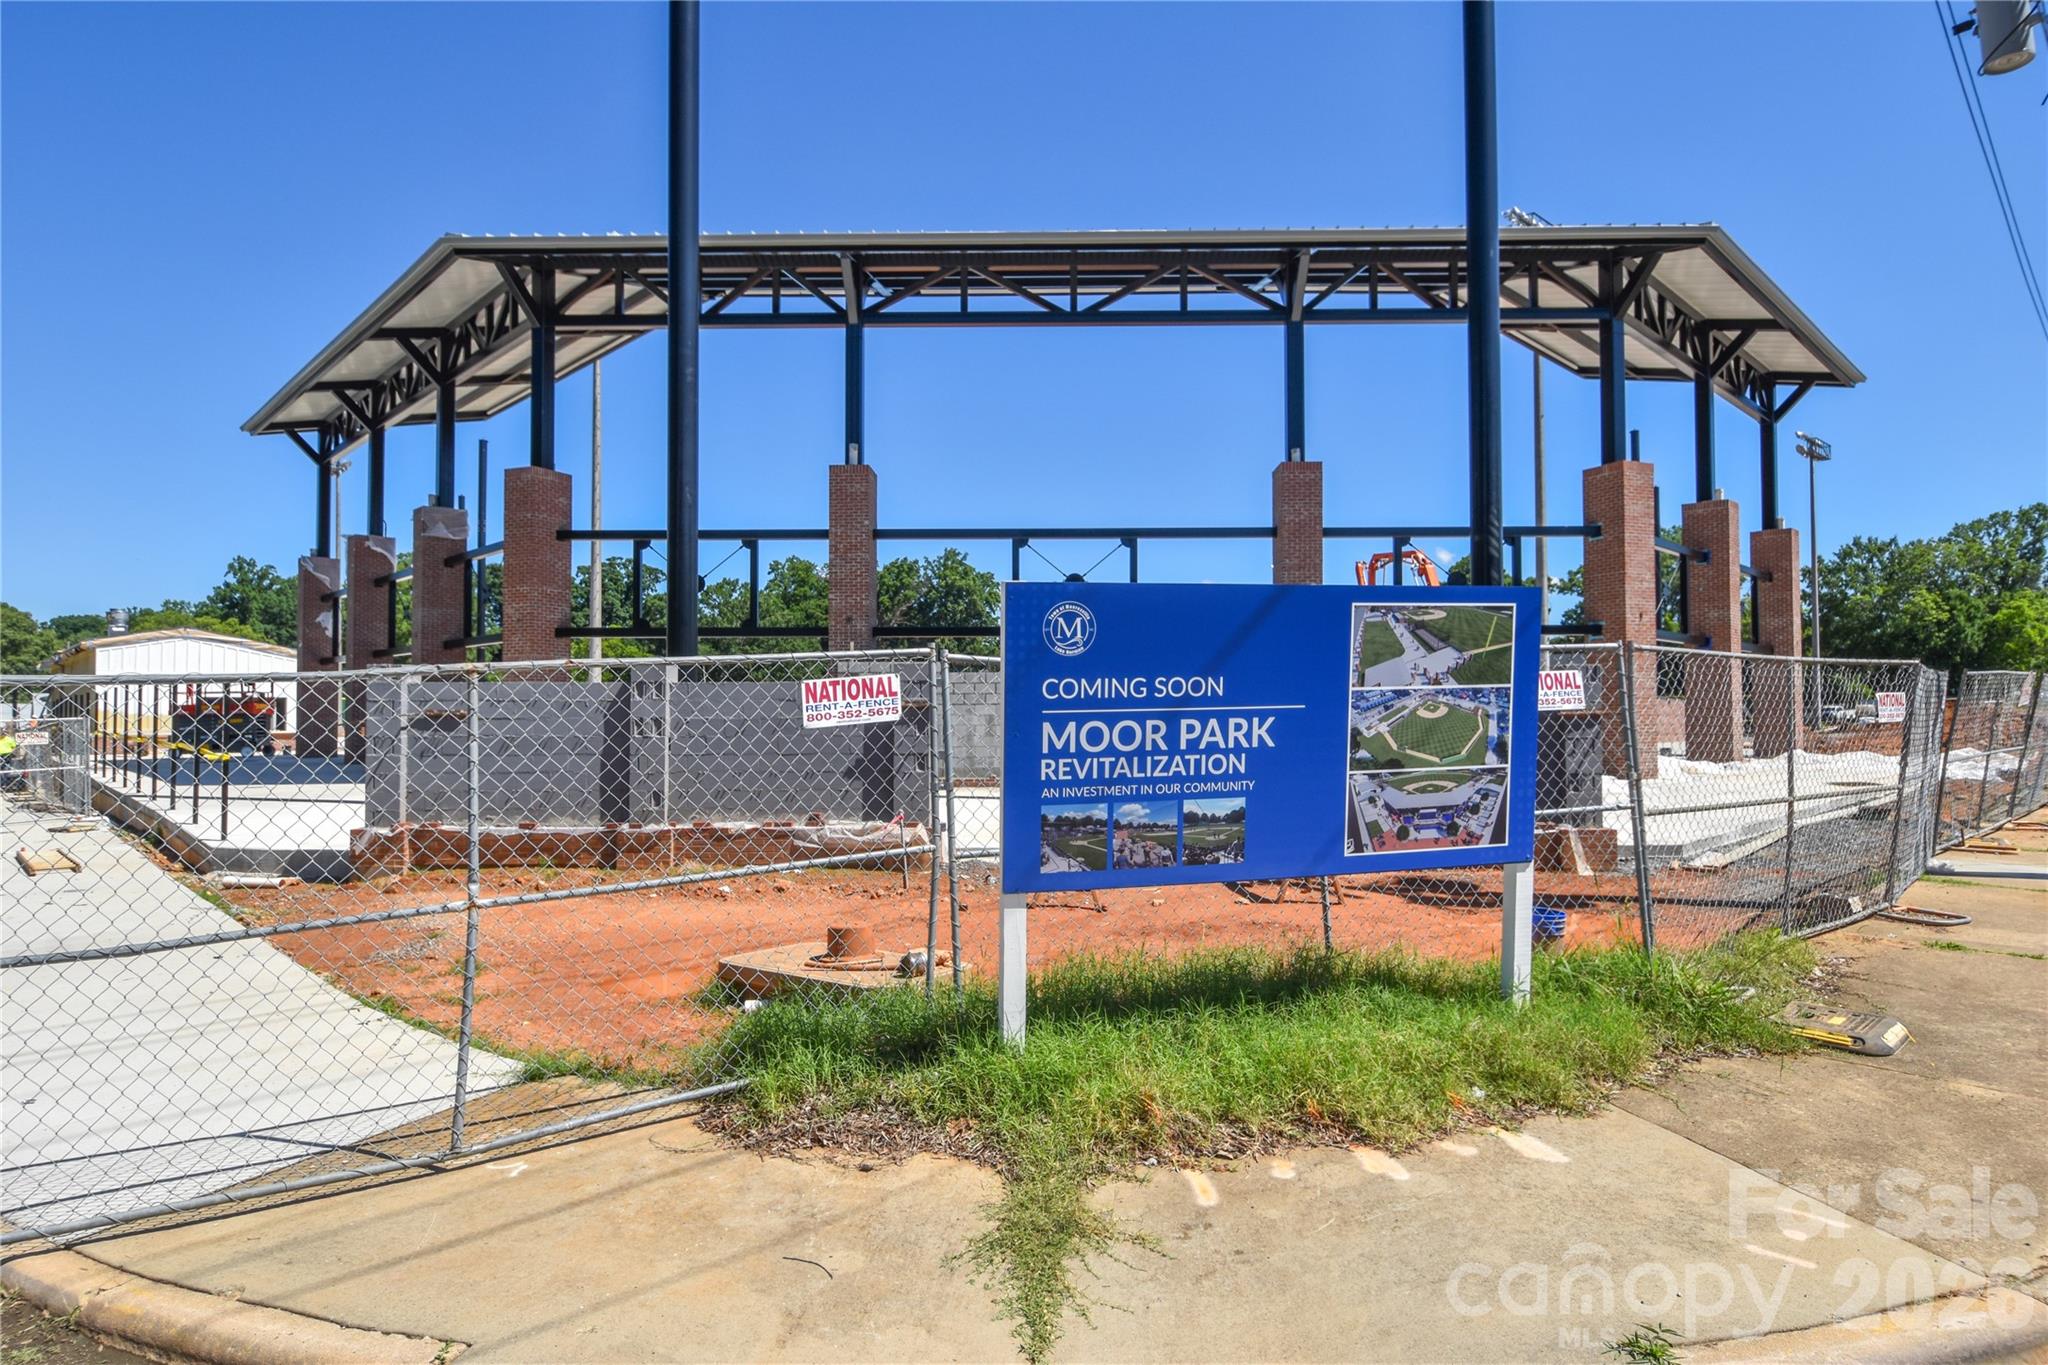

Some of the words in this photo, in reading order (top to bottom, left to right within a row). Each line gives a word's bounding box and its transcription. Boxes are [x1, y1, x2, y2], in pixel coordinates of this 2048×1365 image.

[1055, 616, 1084, 639] M
[804, 675, 899, 705] NATIONAL
[1041, 677, 1147, 700] COMING
[1153, 676, 1225, 698] SOON
[1538, 671, 1582, 691] IONAL
[1538, 697, 1584, 706] 352-5675
[1539, 690, 1583, 698] -A-FENCE
[805, 697, 899, 713] RENT-A-FENCE
[806, 706, 899, 723] 800-352-5675
[1041, 718, 1169, 754] MOOR
[1179, 716, 1276, 751] PARK
[1040, 752, 1247, 781] REVITALIZATION
[1041, 786, 1060, 798] AN
[1062, 785, 1139, 798] INVESTMENT
[1140, 784, 1154, 795] IN
[1155, 783, 1182, 795] OUR
[1183, 780, 1256, 793] COMMUNITY
